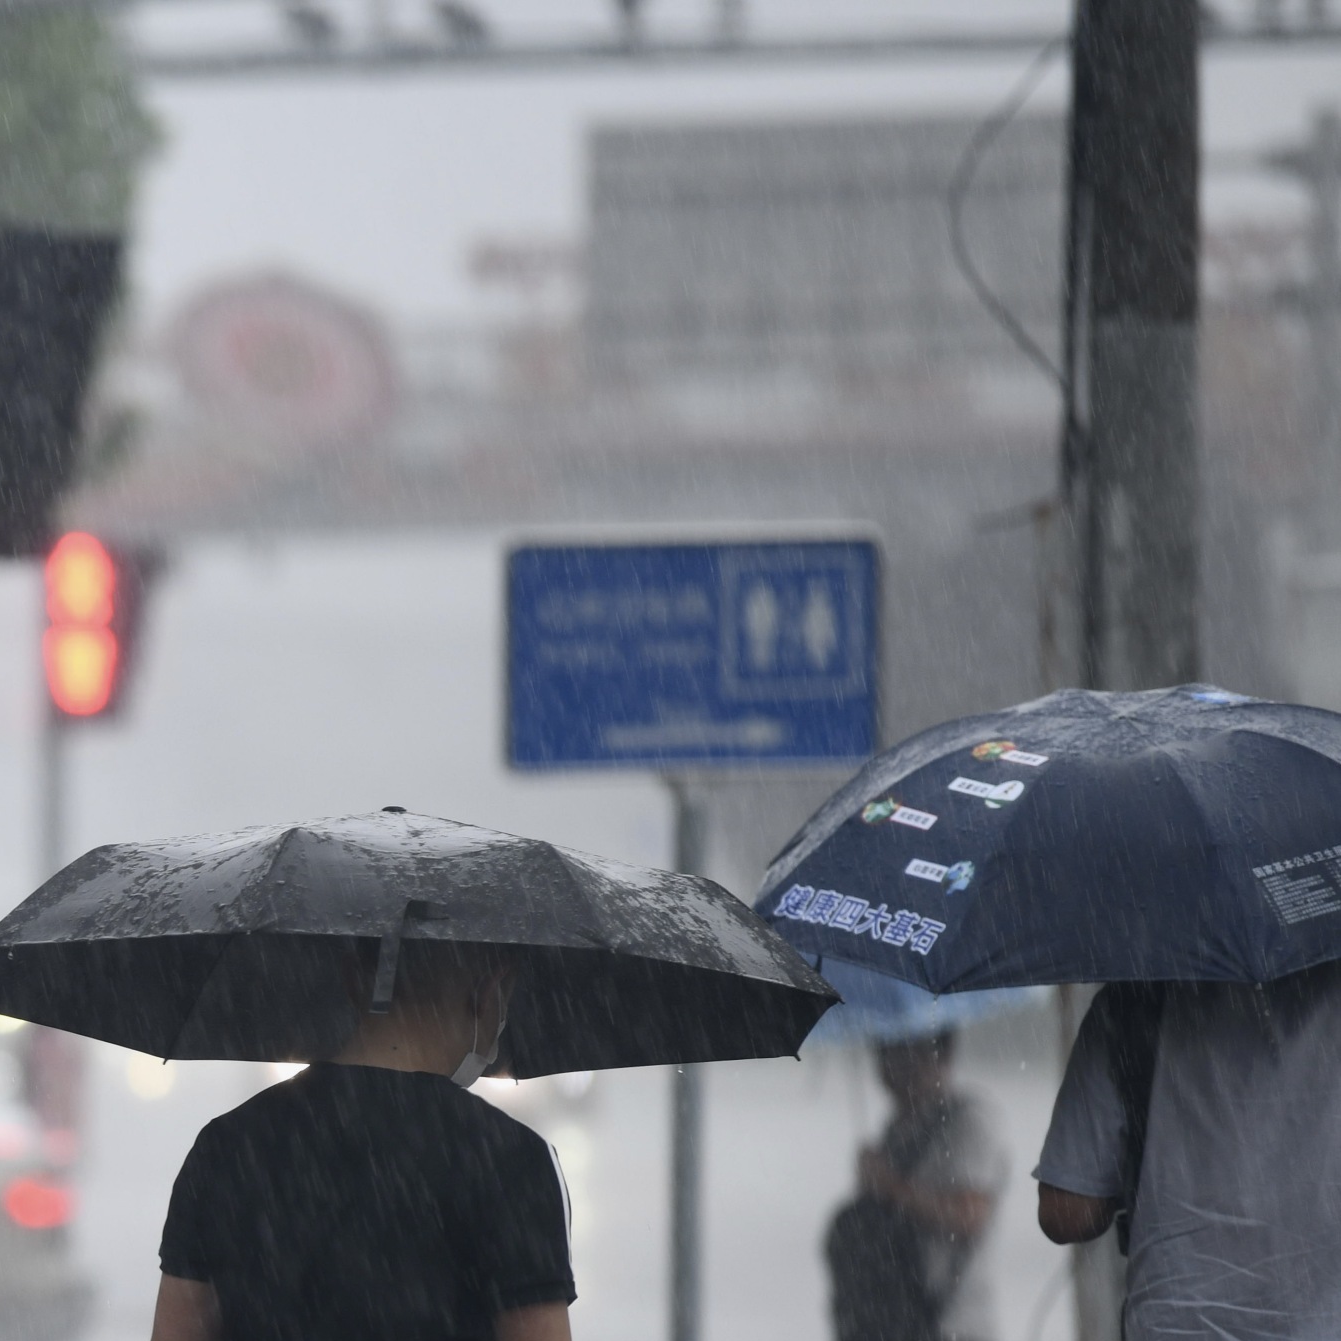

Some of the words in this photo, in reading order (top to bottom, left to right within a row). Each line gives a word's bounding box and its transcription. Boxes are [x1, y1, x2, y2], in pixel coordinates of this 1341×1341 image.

[774, 883, 946, 956] 健康四大基石
